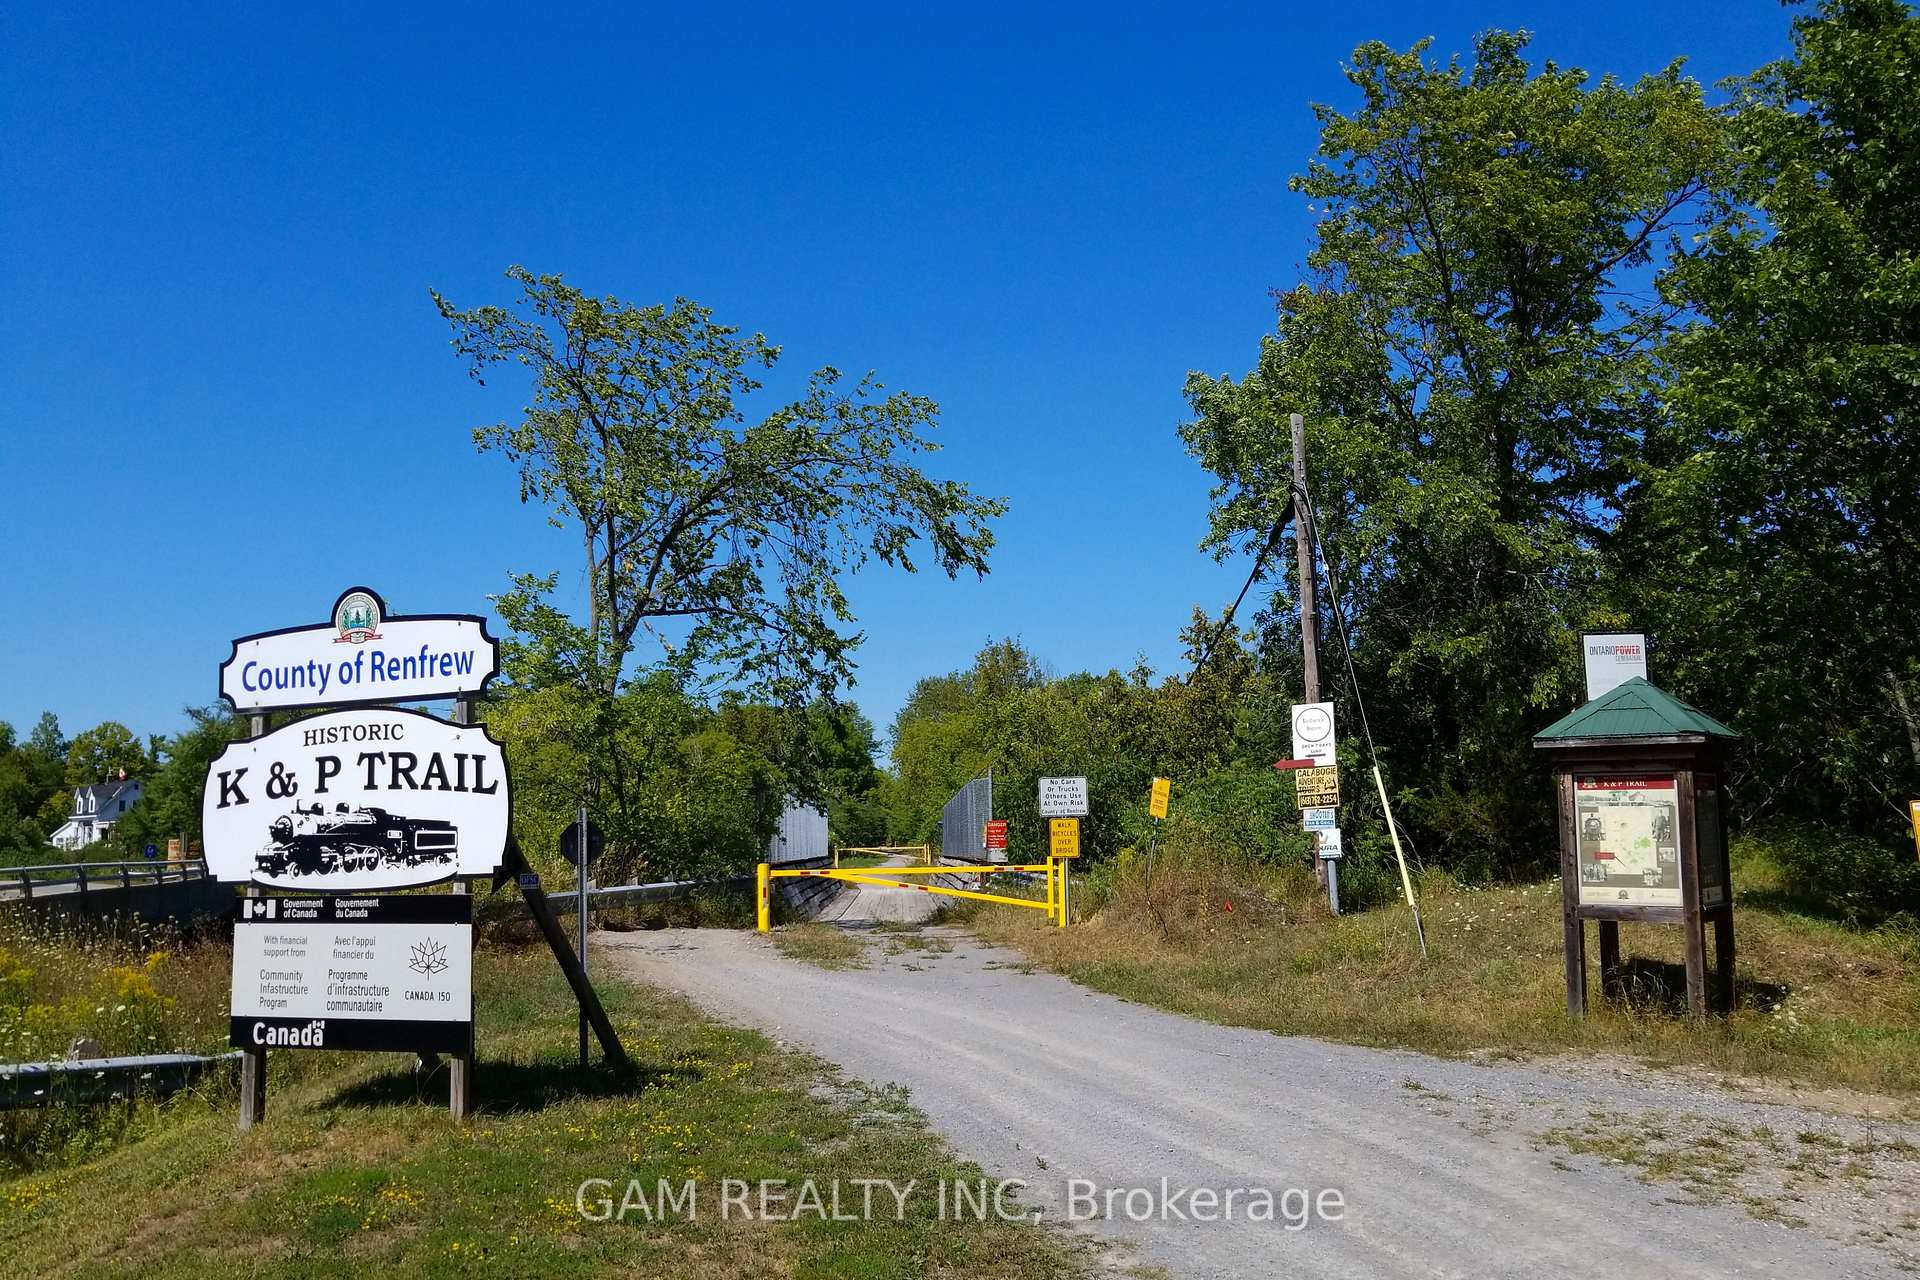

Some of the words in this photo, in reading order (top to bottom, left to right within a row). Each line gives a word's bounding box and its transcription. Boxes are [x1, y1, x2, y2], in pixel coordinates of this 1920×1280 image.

[241, 658, 332, 696] County
[338, 650, 364, 685] of
[370, 643, 475, 683] Renfrew
[303, 723, 404, 747] HISTORIC
[1297, 767, 1336, 778] CALABOGIE
[216, 766, 249, 809] K
[265, 761, 298, 800] &
[314, 755, 342, 794] P
[356, 750, 499, 795] TRAIL
[1298, 776, 1325, 786] ADVENTURE
[1298, 785, 1320, 794] TOURS
[283, 898, 324, 909] Government
[335, 898, 379, 908] Gouvernement
[283, 908, 291, 918] of
[292, 908, 318, 918] Canada
[336, 908, 344, 918] du
[344, 908, 368, 918] Canada
[264, 936, 278, 945] With
[280, 936, 308, 945] financial
[334, 936, 350, 946] Avec
[264, 948, 289, 958] support
[290, 948, 306, 958] from
[333, 949, 364, 960] financier
[365, 950, 374, 960] du
[260, 969, 303, 982] Community
[328, 969, 368, 982] Programme
[327, 984, 390, 997] d'infrastructure
[404, 990, 434, 1001] CANADA
[438, 992, 451, 1002] 150
[259, 998, 288, 1010] Program
[326, 999, 383, 1013] communautaire
[252, 1020, 325, 1047] Canada
